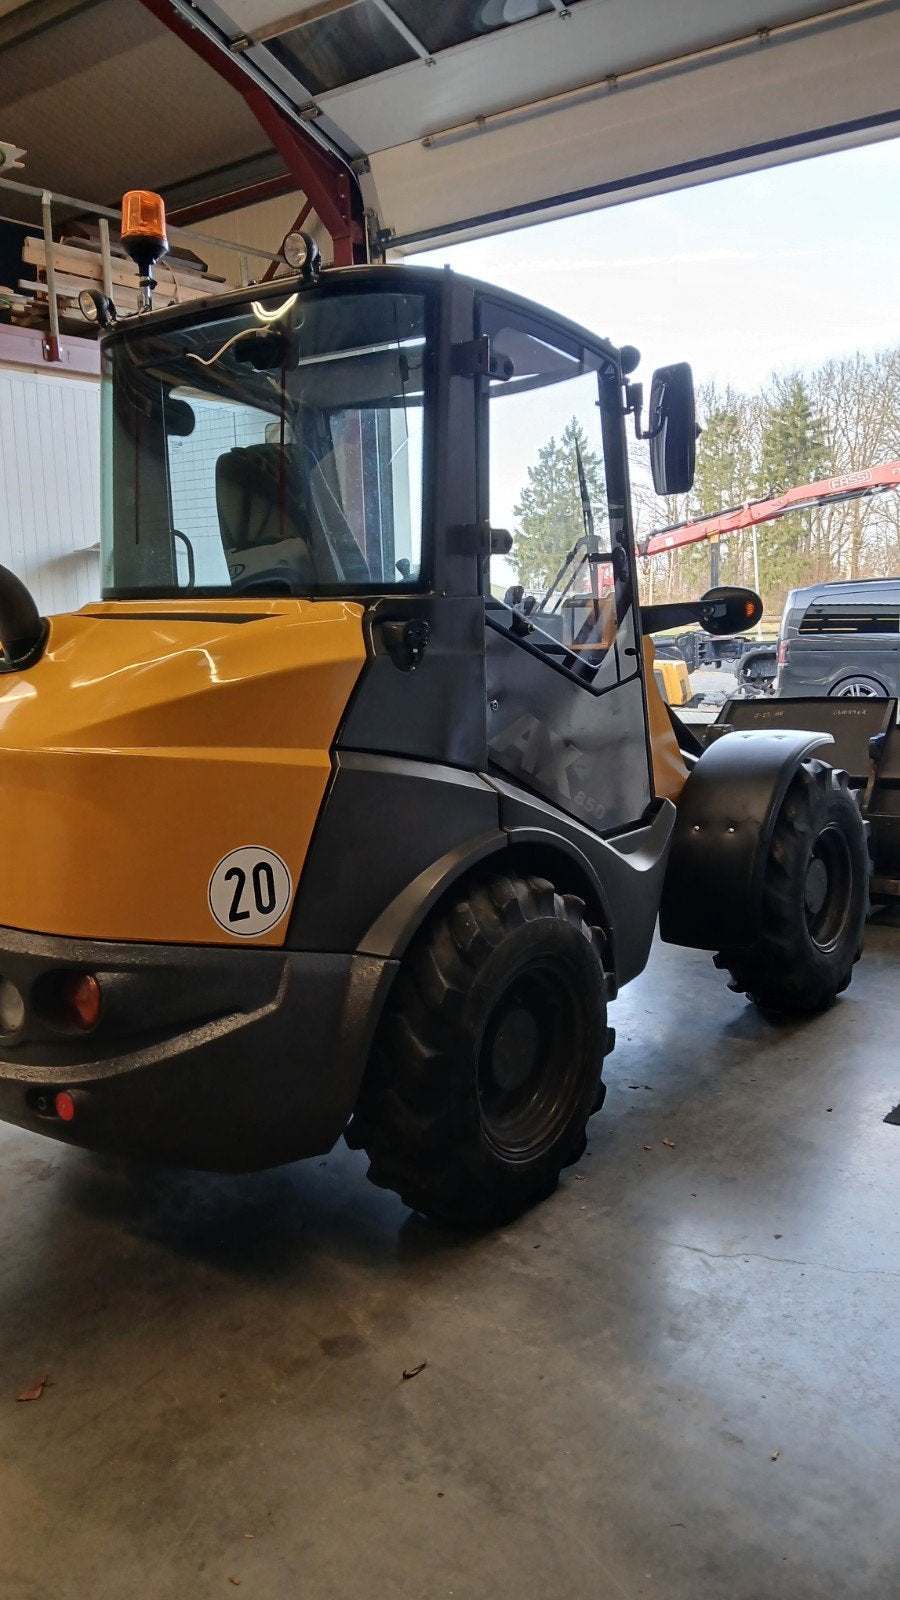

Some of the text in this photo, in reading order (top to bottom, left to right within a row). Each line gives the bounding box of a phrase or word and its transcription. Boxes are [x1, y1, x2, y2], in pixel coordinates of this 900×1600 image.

[831, 471, 870, 489] FASSI
[574, 791, 605, 819] 850
[224, 861, 277, 922] 20
